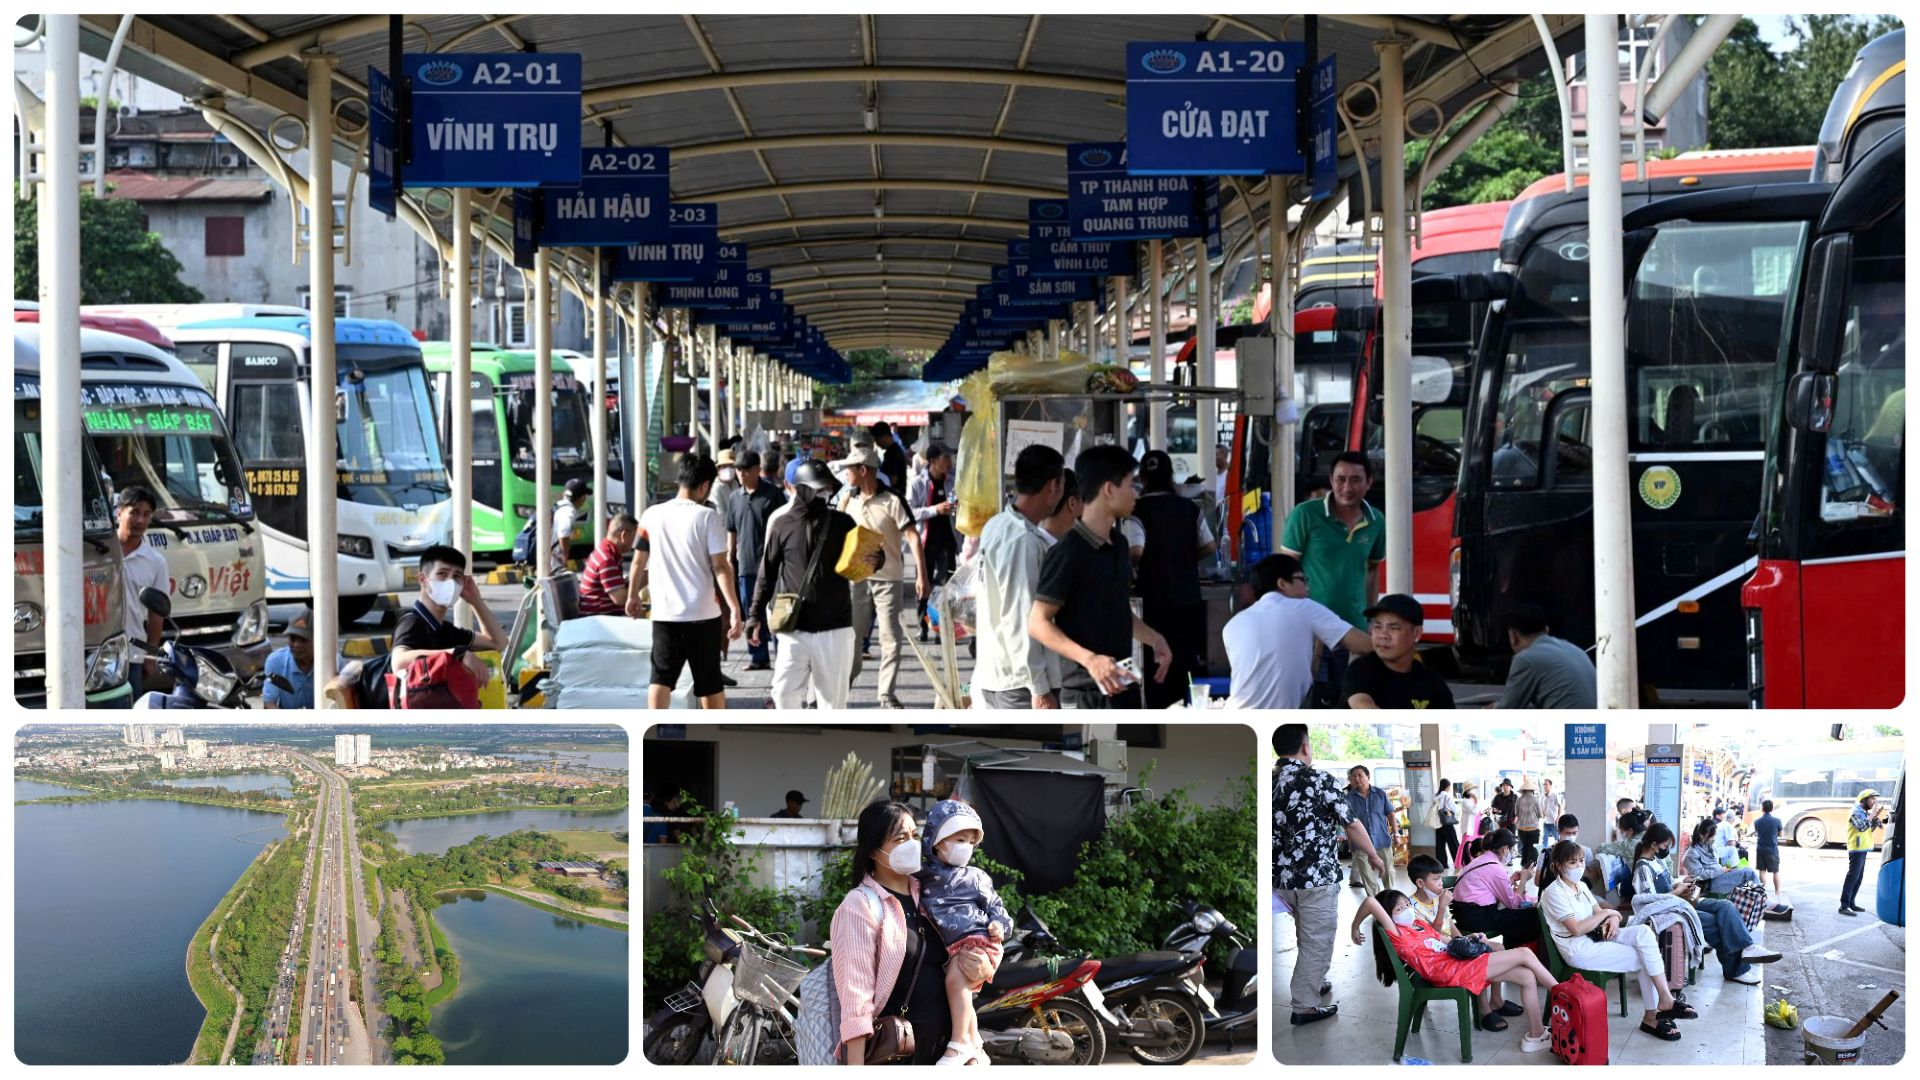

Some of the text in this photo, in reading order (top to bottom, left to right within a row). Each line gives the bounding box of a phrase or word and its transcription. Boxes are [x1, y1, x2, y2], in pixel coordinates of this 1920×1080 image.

[1196, 50, 1285, 73] A1-20
[472, 62, 562, 85] A2-01
[1162, 101, 1269, 144] CỬA ĐẠT
[427, 117, 557, 157] VĨNH TRỤ
[588, 153, 656, 171] A2-02
[1080, 181, 1098, 194] TP
[1103, 179, 1153, 194] THANH
[557, 191, 651, 223] HẢI HẬU
[669, 208, 707, 222] 2-03
[1102, 197, 1168, 215] TAM HỢP
[1038, 227, 1053, 238] TP
[1083, 217, 1134, 232] QUANG
[1140, 215, 1189, 231] TRUNG
[672, 244, 705, 264] TRỤ
[717, 246, 738, 259] -04
[1016, 264, 1028, 277] TP
[669, 286, 739, 301] THỊNH LONG
[245, 356, 278, 367] SAMCO
[146, 409, 181, 430] GIÁP
[185, 409, 213, 431] BÁT
[1654, 480, 1666, 490] VIP
[147, 532, 168, 549] TRỤ
[202, 527, 222, 544] GIÁP
[224, 526, 240, 542] BÁT
[208, 566, 252, 598] Việt
